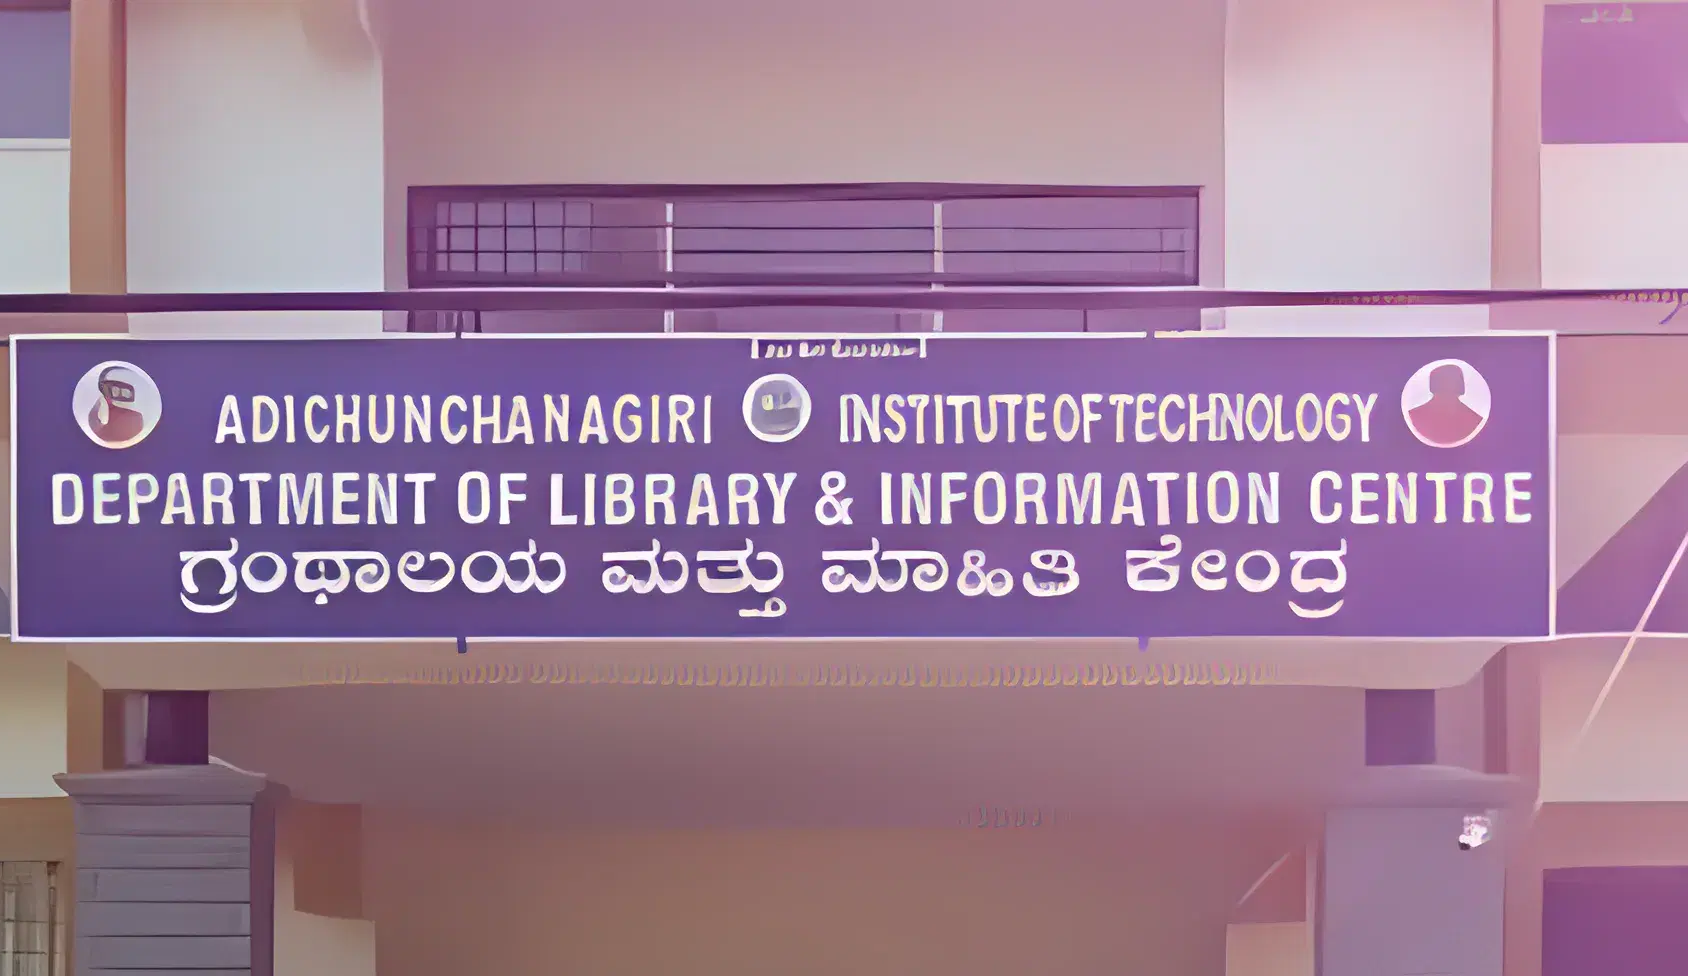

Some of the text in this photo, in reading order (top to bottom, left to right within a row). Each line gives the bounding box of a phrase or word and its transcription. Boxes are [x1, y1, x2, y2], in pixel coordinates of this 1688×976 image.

[213, 391, 1380, 444] ADICHUNCHANAGIRI INSTITUTE OF TECHNOLOGY
[50, 469, 1533, 526] DEPARTMENT OF LIBRARY & INFORMATION CENTRE
[178, 533, 1348, 619] ಗ್ರಂಥಾಲಯ ಮತ್ತು ಮಾಹಿತಿ ಕೇಂದ್ರ
